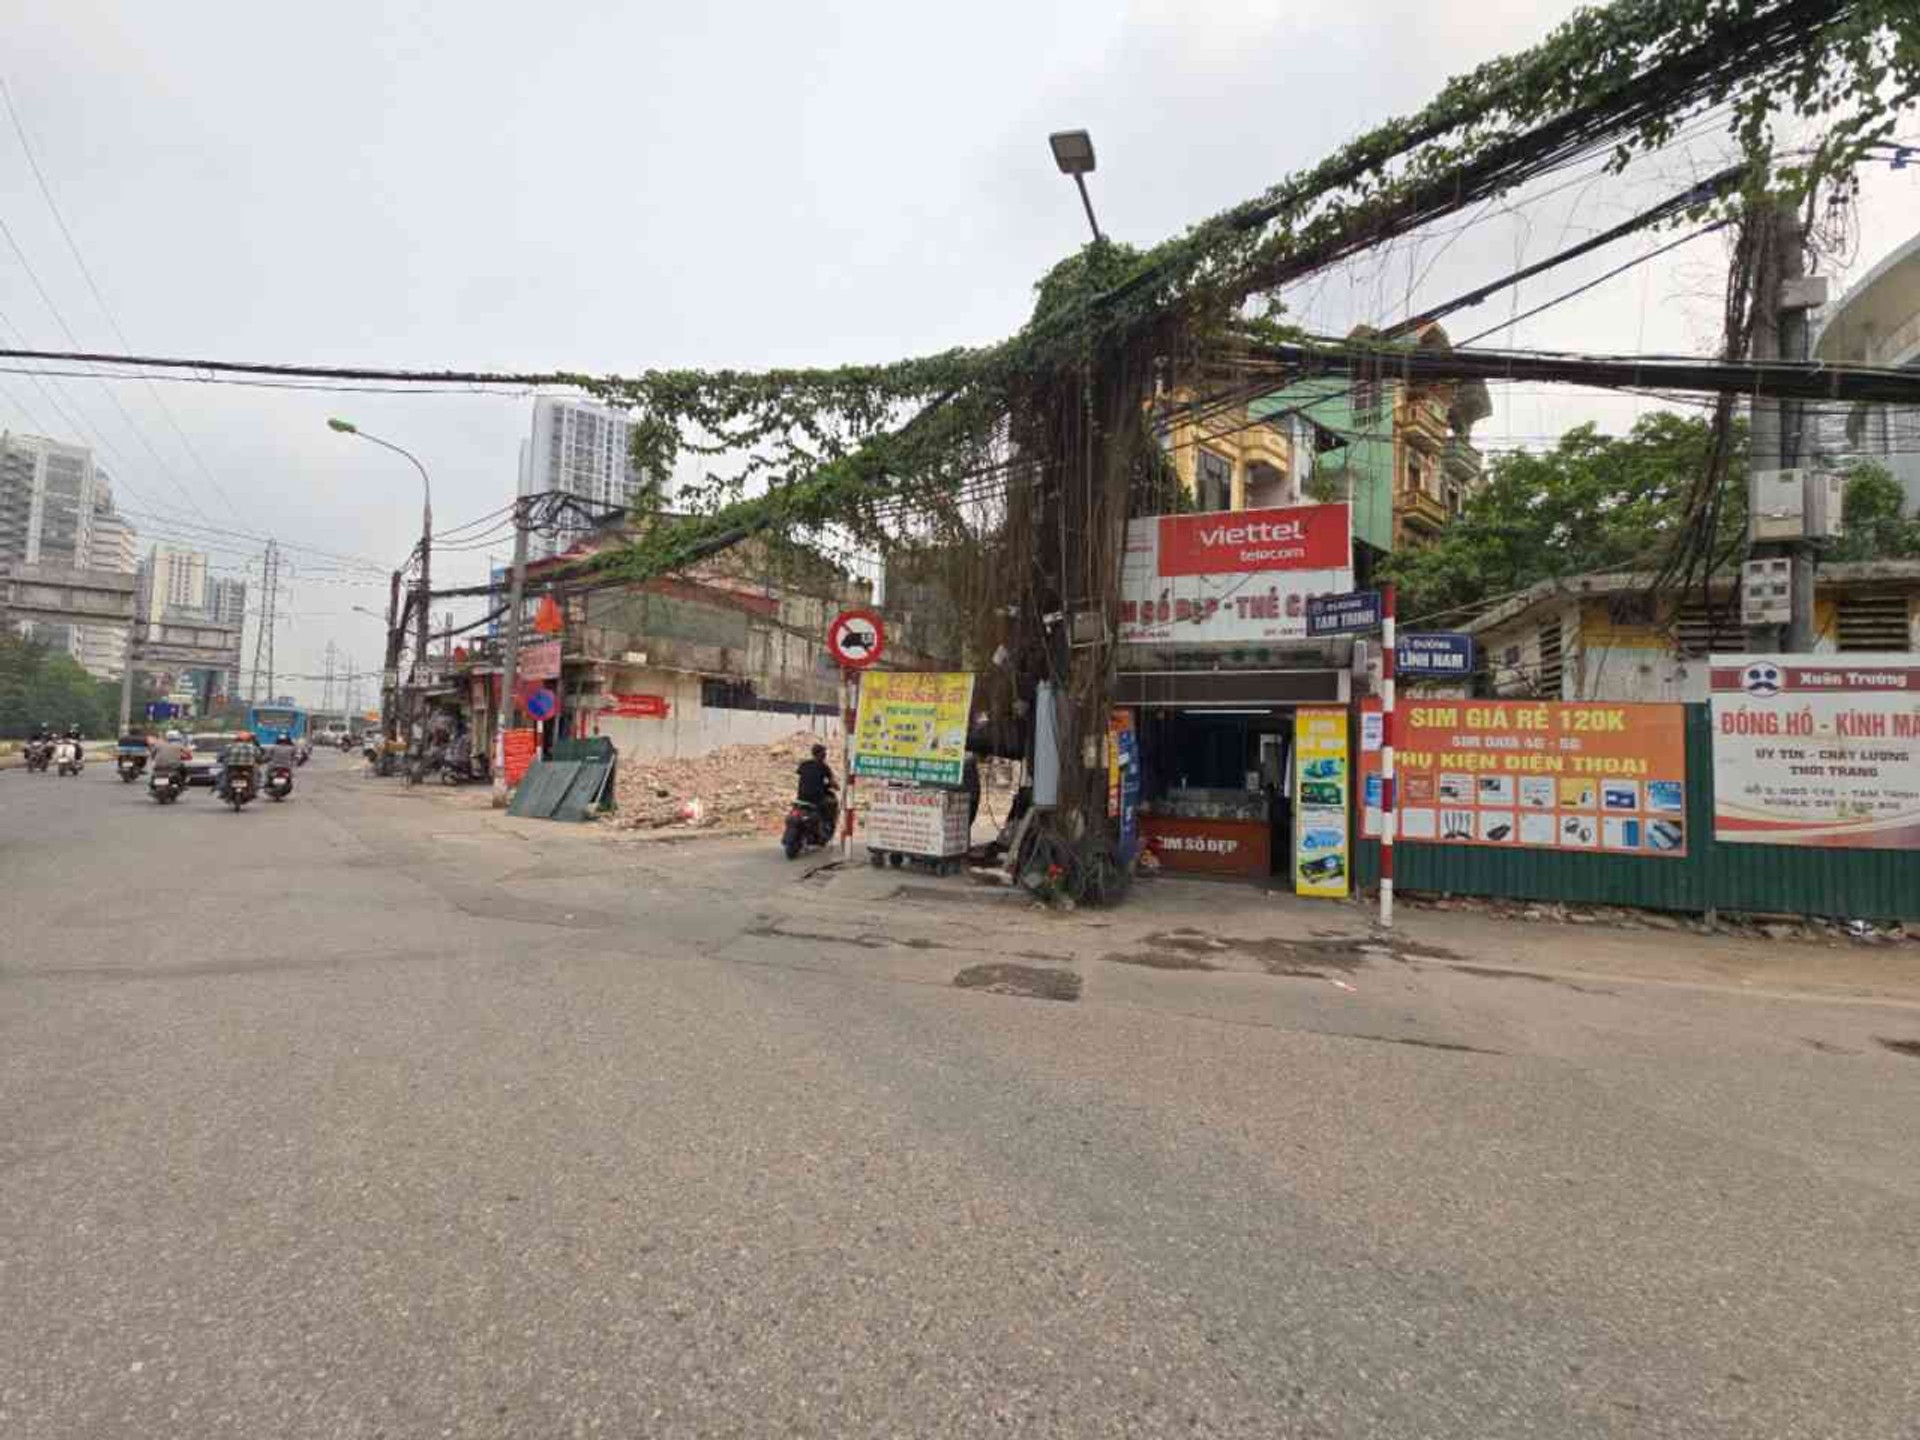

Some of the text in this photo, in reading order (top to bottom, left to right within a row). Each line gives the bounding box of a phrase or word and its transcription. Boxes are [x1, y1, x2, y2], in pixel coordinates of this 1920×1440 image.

[1199, 520, 1305, 547] viettel
[1239, 547, 1305, 563] telecom
[1432, 653, 1464, 669] NAM
[1800, 671, 1843, 686] Xuân
[1409, 702, 1625, 731] SIM GIÁ RẺ 120K
[1439, 751, 1497, 771] KIỆN
[1571, 757, 1648, 777] THOẠI
[1828, 765, 1879, 778] TRANG
